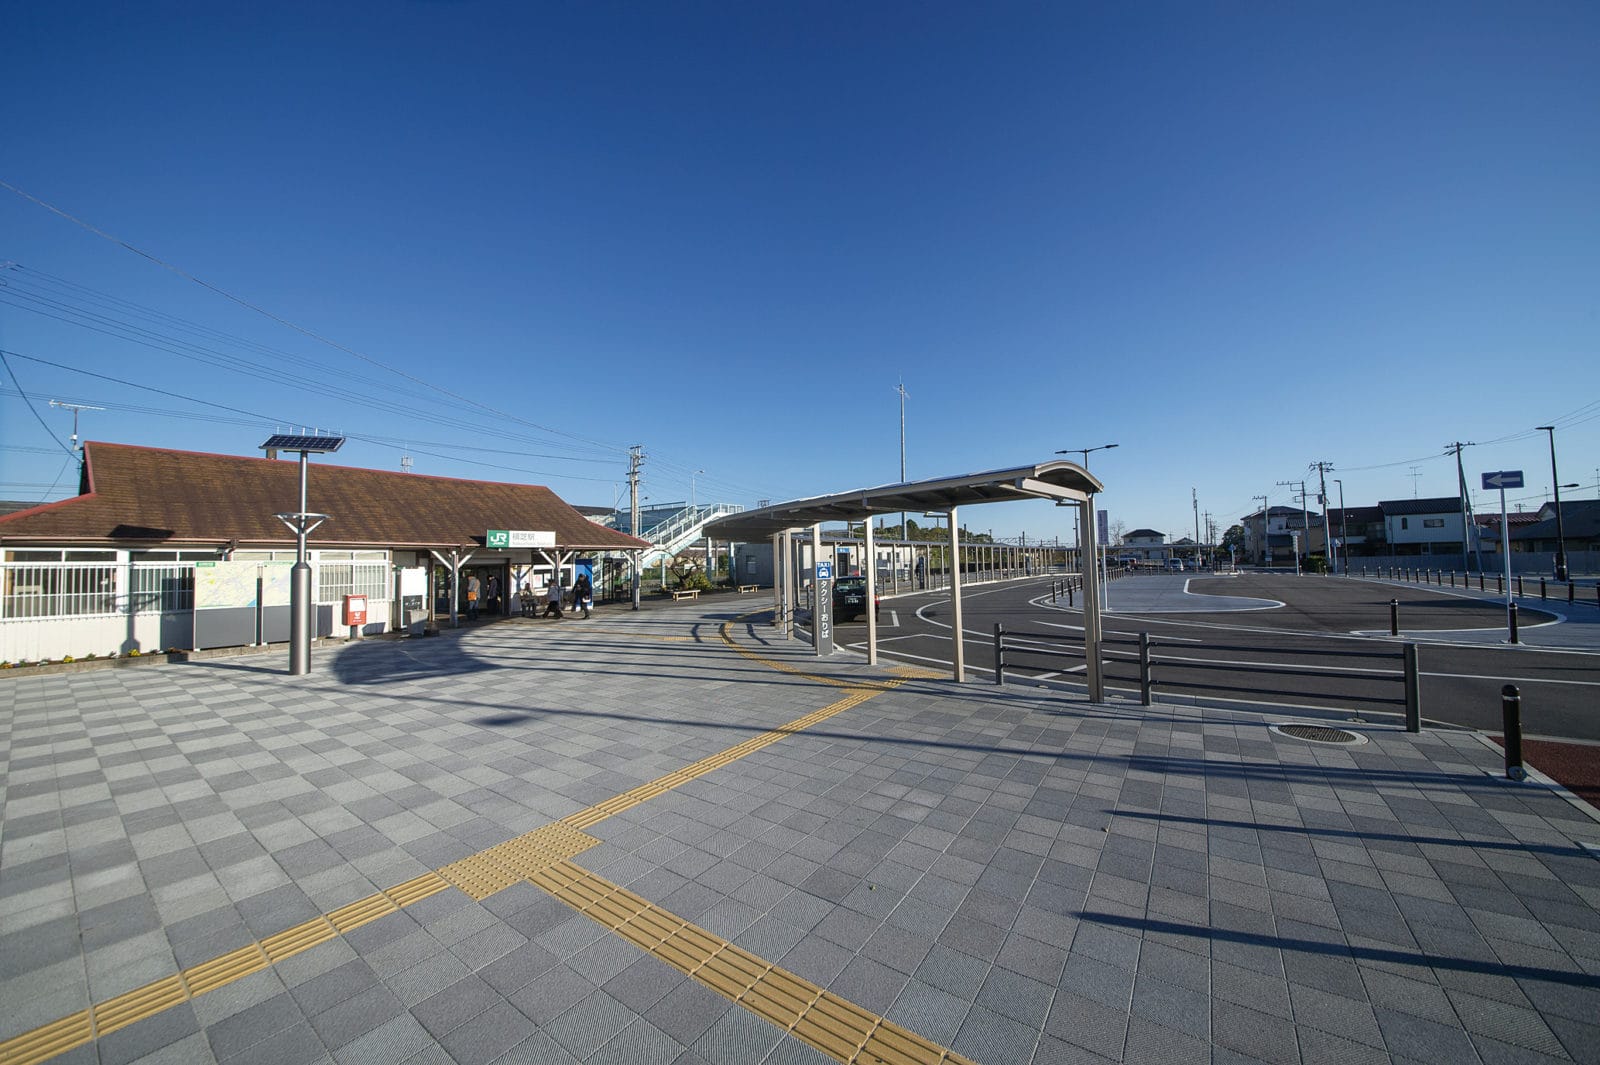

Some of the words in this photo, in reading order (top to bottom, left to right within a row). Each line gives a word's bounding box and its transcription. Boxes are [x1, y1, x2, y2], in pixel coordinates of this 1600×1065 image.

[490, 532, 507, 542] JR
[821, 580, 829, 638] タクシーおりば
